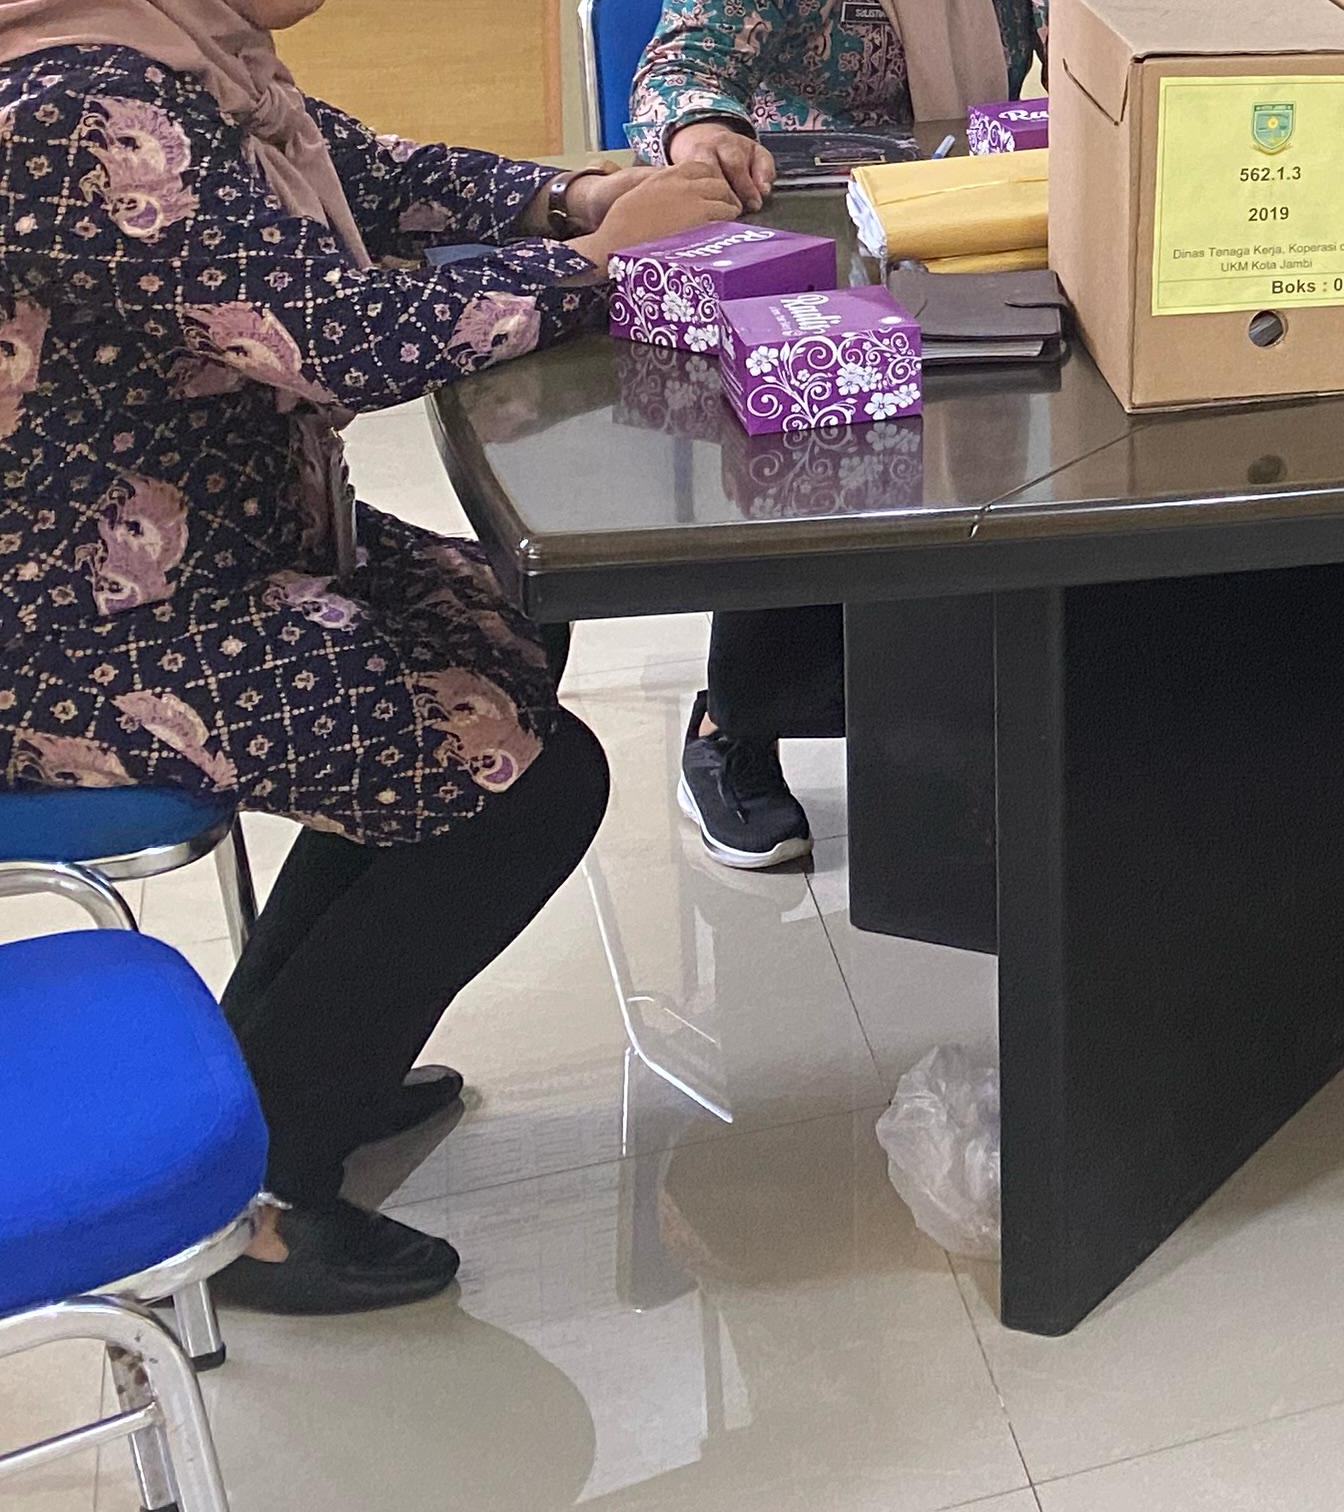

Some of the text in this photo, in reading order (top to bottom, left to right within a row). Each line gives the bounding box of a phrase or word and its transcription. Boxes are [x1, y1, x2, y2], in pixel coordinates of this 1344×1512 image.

[1240, 166, 1302, 182] 562.1.3
[1248, 206, 1289, 221] 2019
[1173, 249, 1205, 259] Dinas
[1209, 247, 1250, 259] Tenaga
[1253, 245, 1285, 257] Kerja,
[1289, 242, 1337, 254] Koperasi
[1221, 258, 1313, 272] UKM Kota Jambi
[1271, 279, 1316, 294] Boks
[1322, 282, 1328, 293] :
